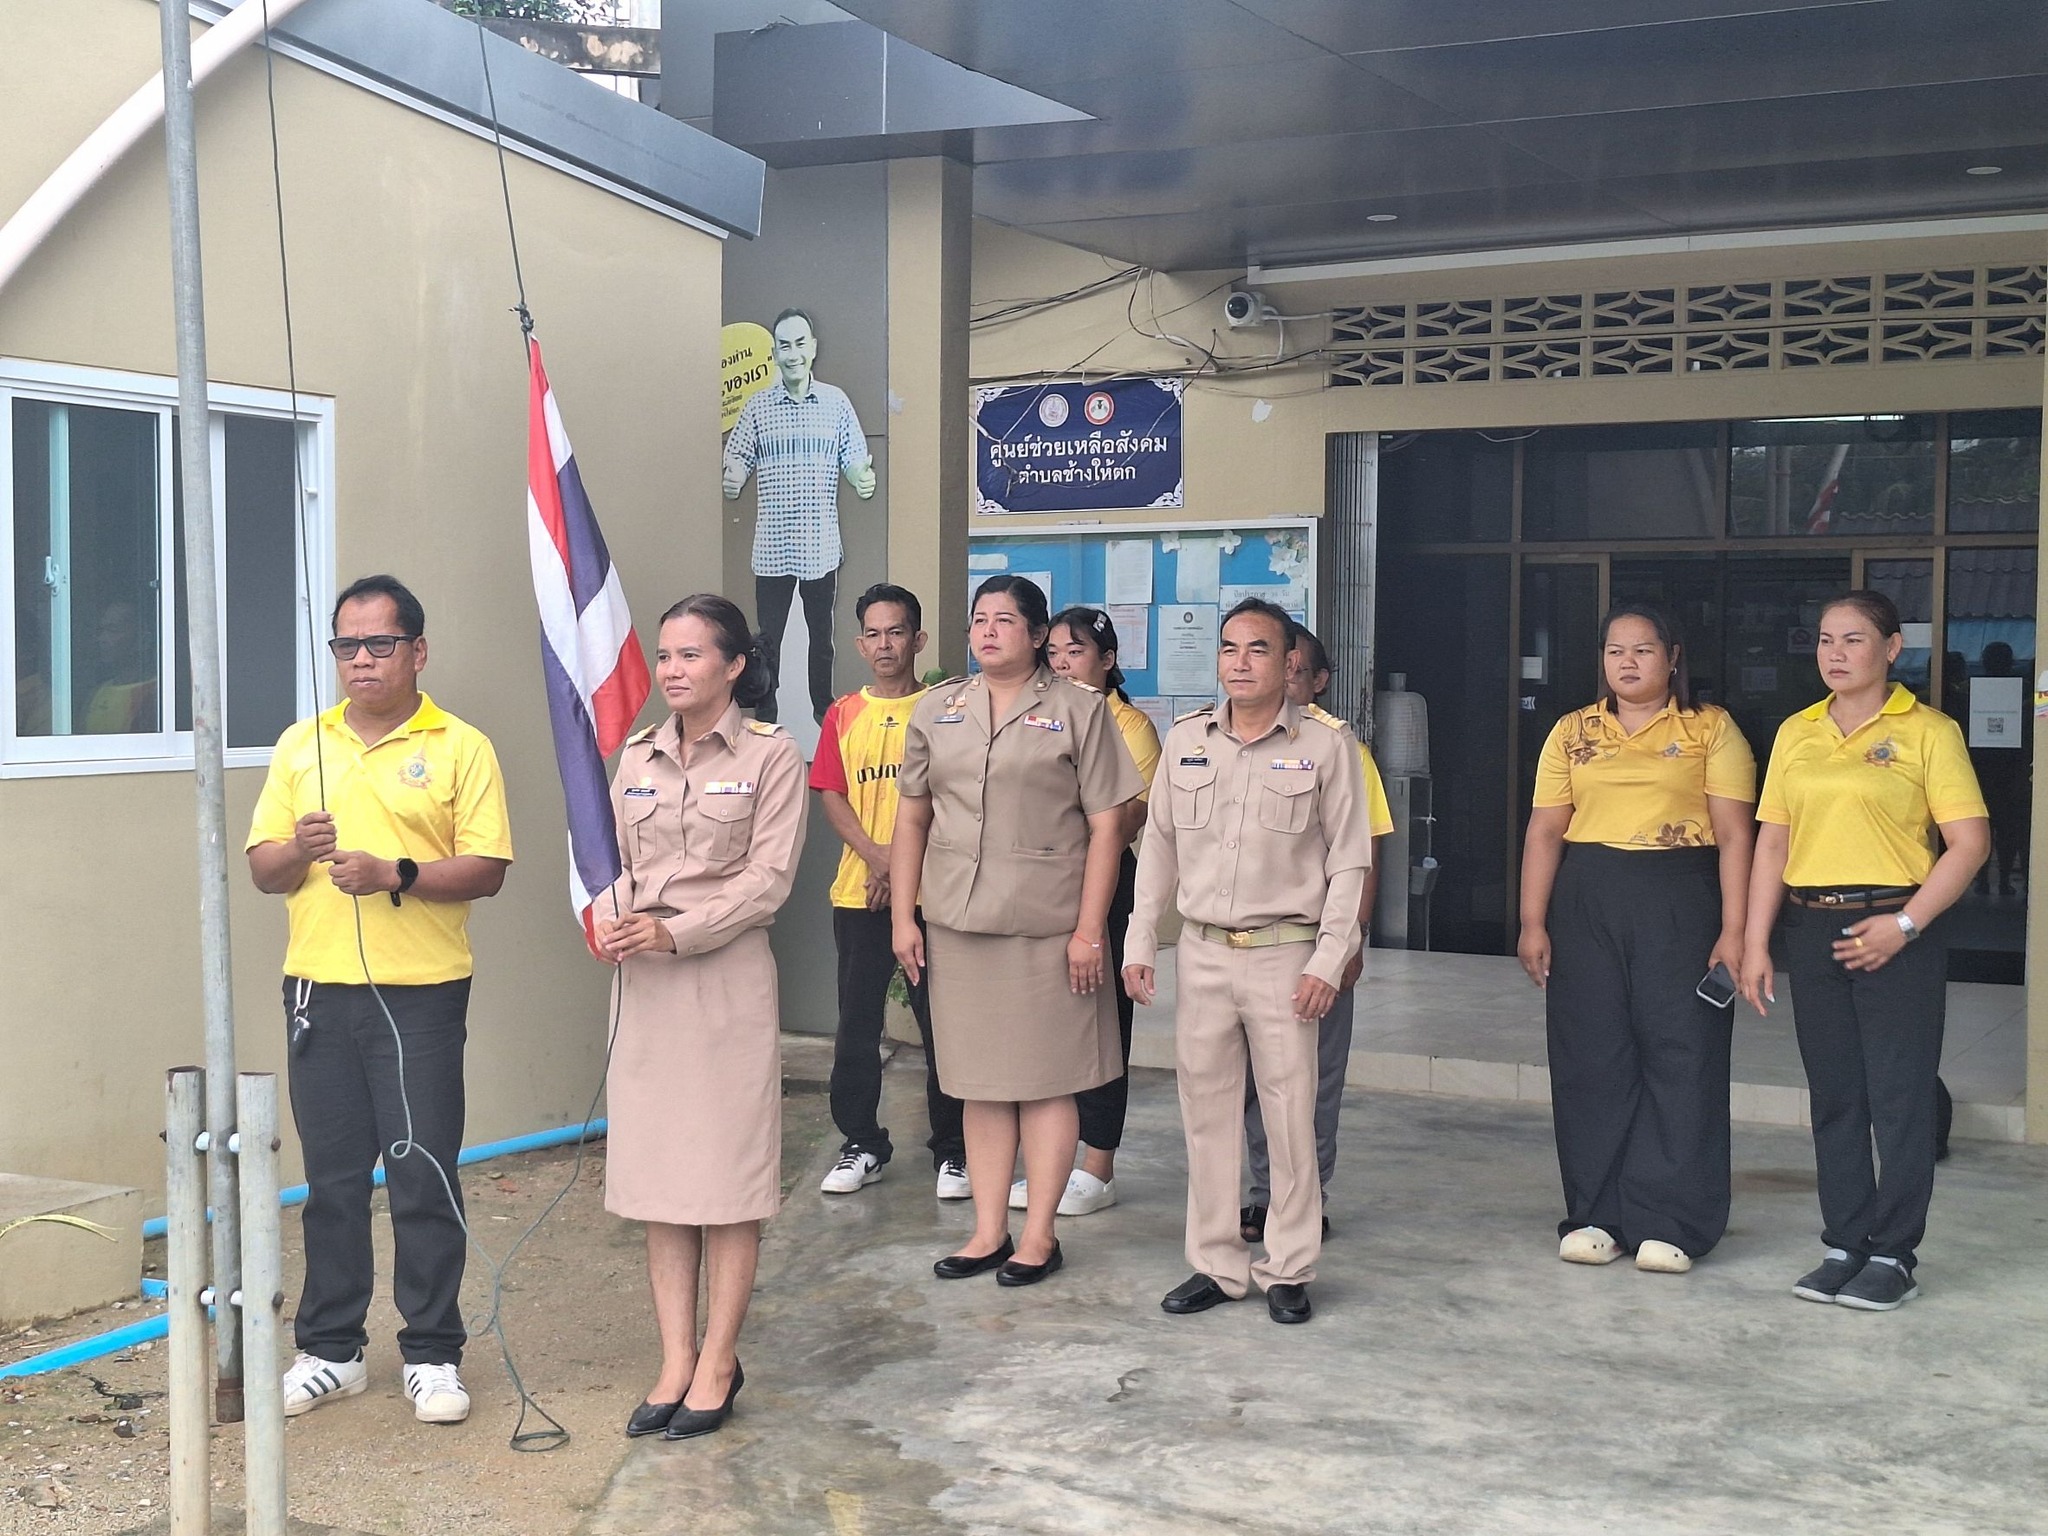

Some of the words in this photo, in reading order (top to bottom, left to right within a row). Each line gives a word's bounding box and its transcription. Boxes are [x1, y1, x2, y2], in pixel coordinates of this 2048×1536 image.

[721, 346, 753, 368] องท่าน
[990, 429, 1167, 467] ศูนย์ช่วยเหลือสังคม
[1018, 458, 1136, 484] ตำบลช้างให้ตก
